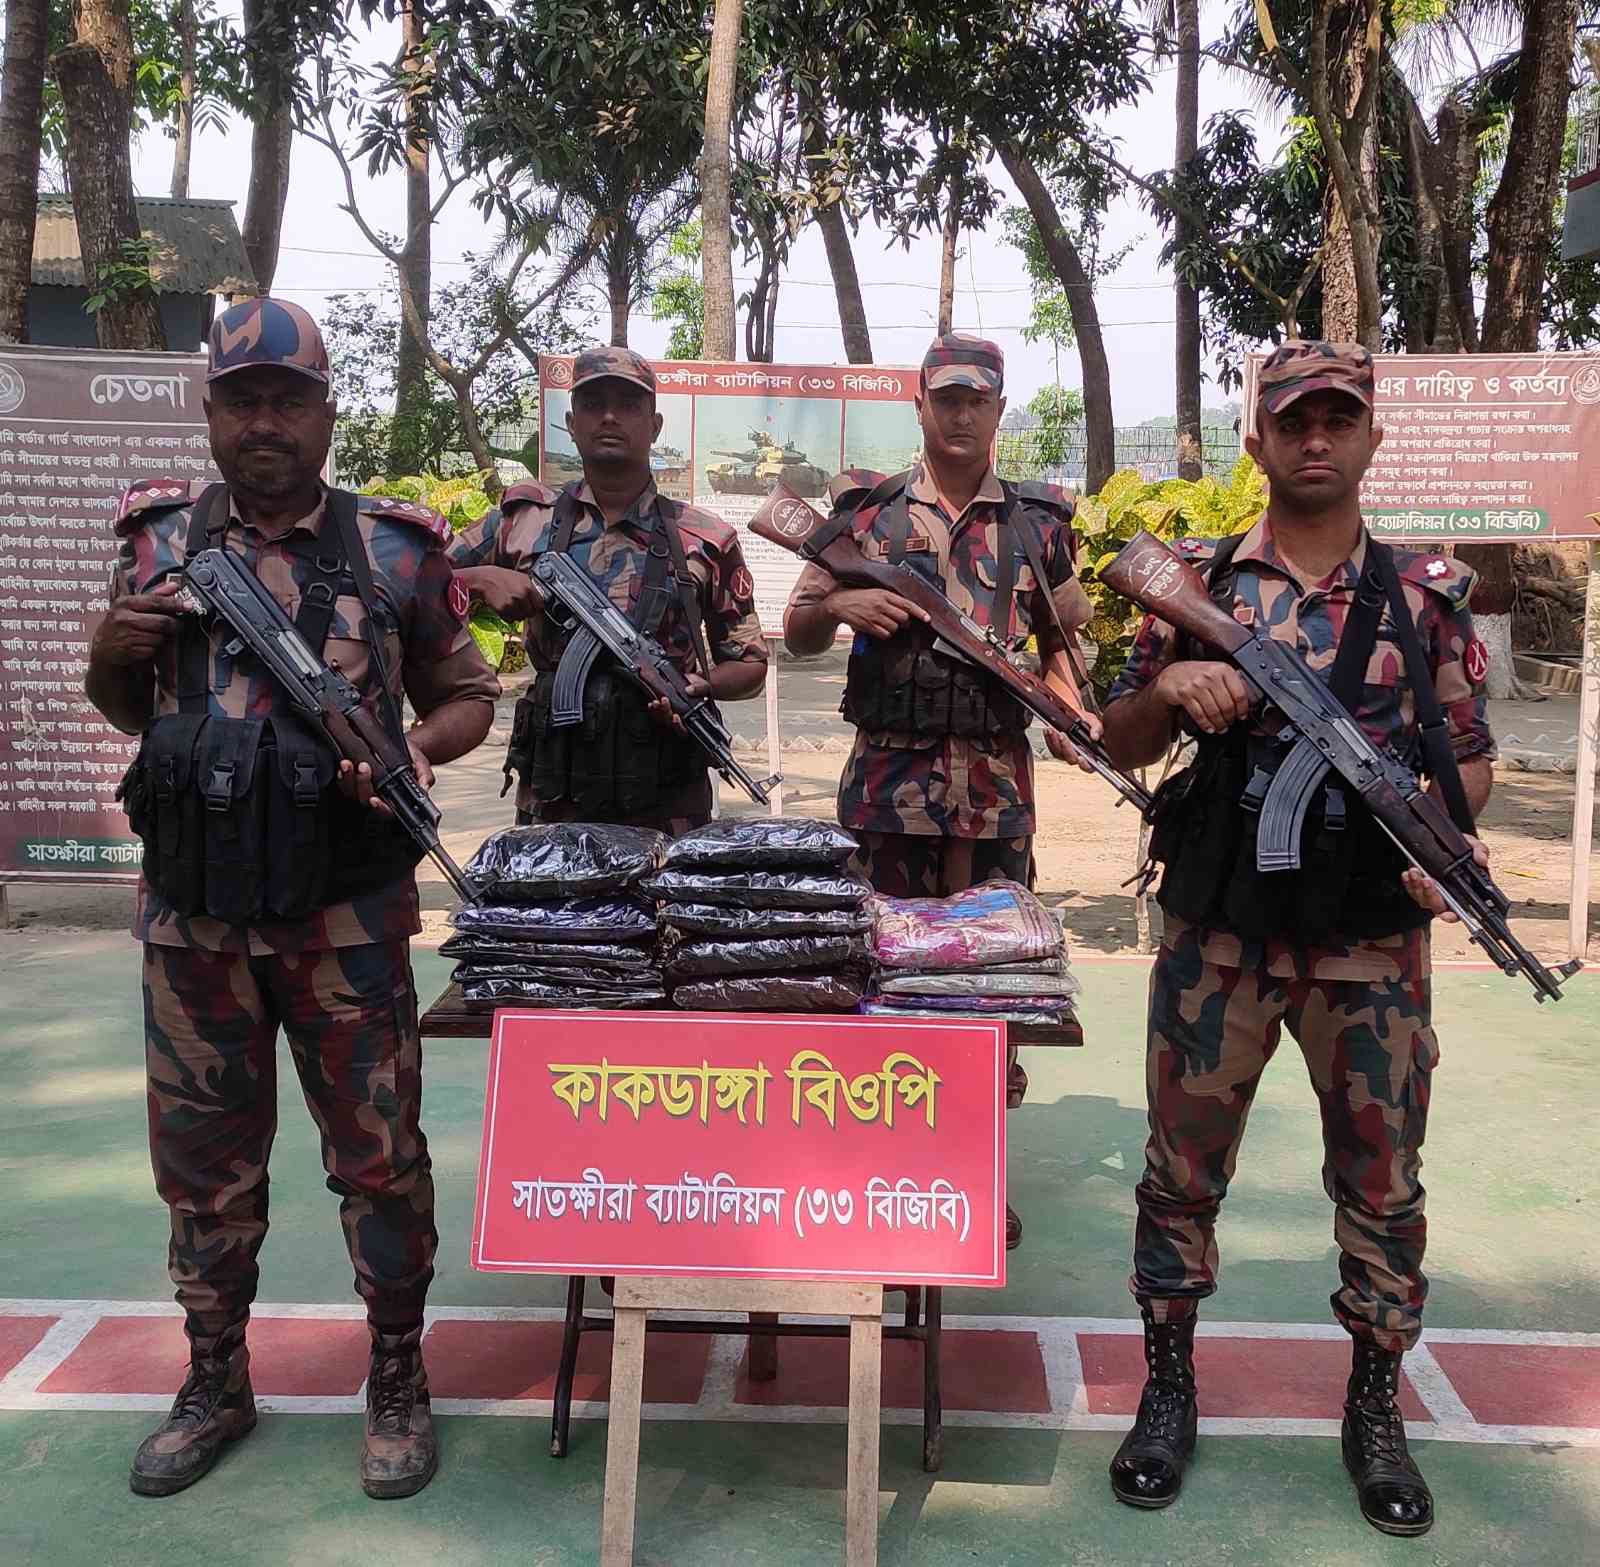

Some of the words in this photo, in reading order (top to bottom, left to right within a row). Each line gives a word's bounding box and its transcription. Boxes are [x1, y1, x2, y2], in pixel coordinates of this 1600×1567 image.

[90, 372, 191, 408] চেতনা
[656, 368, 709, 387] তক্ষীরা
[712, 370, 793, 389] ব্যাটালিয়ন
[799, 375, 836, 392] (৩৩
[842, 374, 902, 396] বিজিবি)
[1375, 376, 1408, 398] এর
[1414, 370, 1477, 401] দায়িত্ব
[1484, 378, 1501, 395] ও
[1506, 367, 1569, 396] কর্তব্য
[17, 430, 46, 445] বর্ডার
[71, 434, 121, 448] বাংলাদেশ
[125, 436, 143, 448] এর
[145, 437, 182, 449] একজন
[1377, 511, 1446, 531] ব্যাটালিয়ন
[1449, 512, 1481, 531] (৩৩
[1484, 510, 1541, 531] বিজিবি)
[26, 840, 97, 863] সাতক্ষীরা
[547, 1056, 775, 1126] কাকডাঙ্গা
[785, 1049, 943, 1130] বিওপি
[511, 1167, 638, 1223] সাতক্ষীরা
[643, 1171, 786, 1226] ব্যাটালিয়ন
[793, 1186, 855, 1239] (৩৩
[864, 1176, 972, 1242] বিজিবি)
